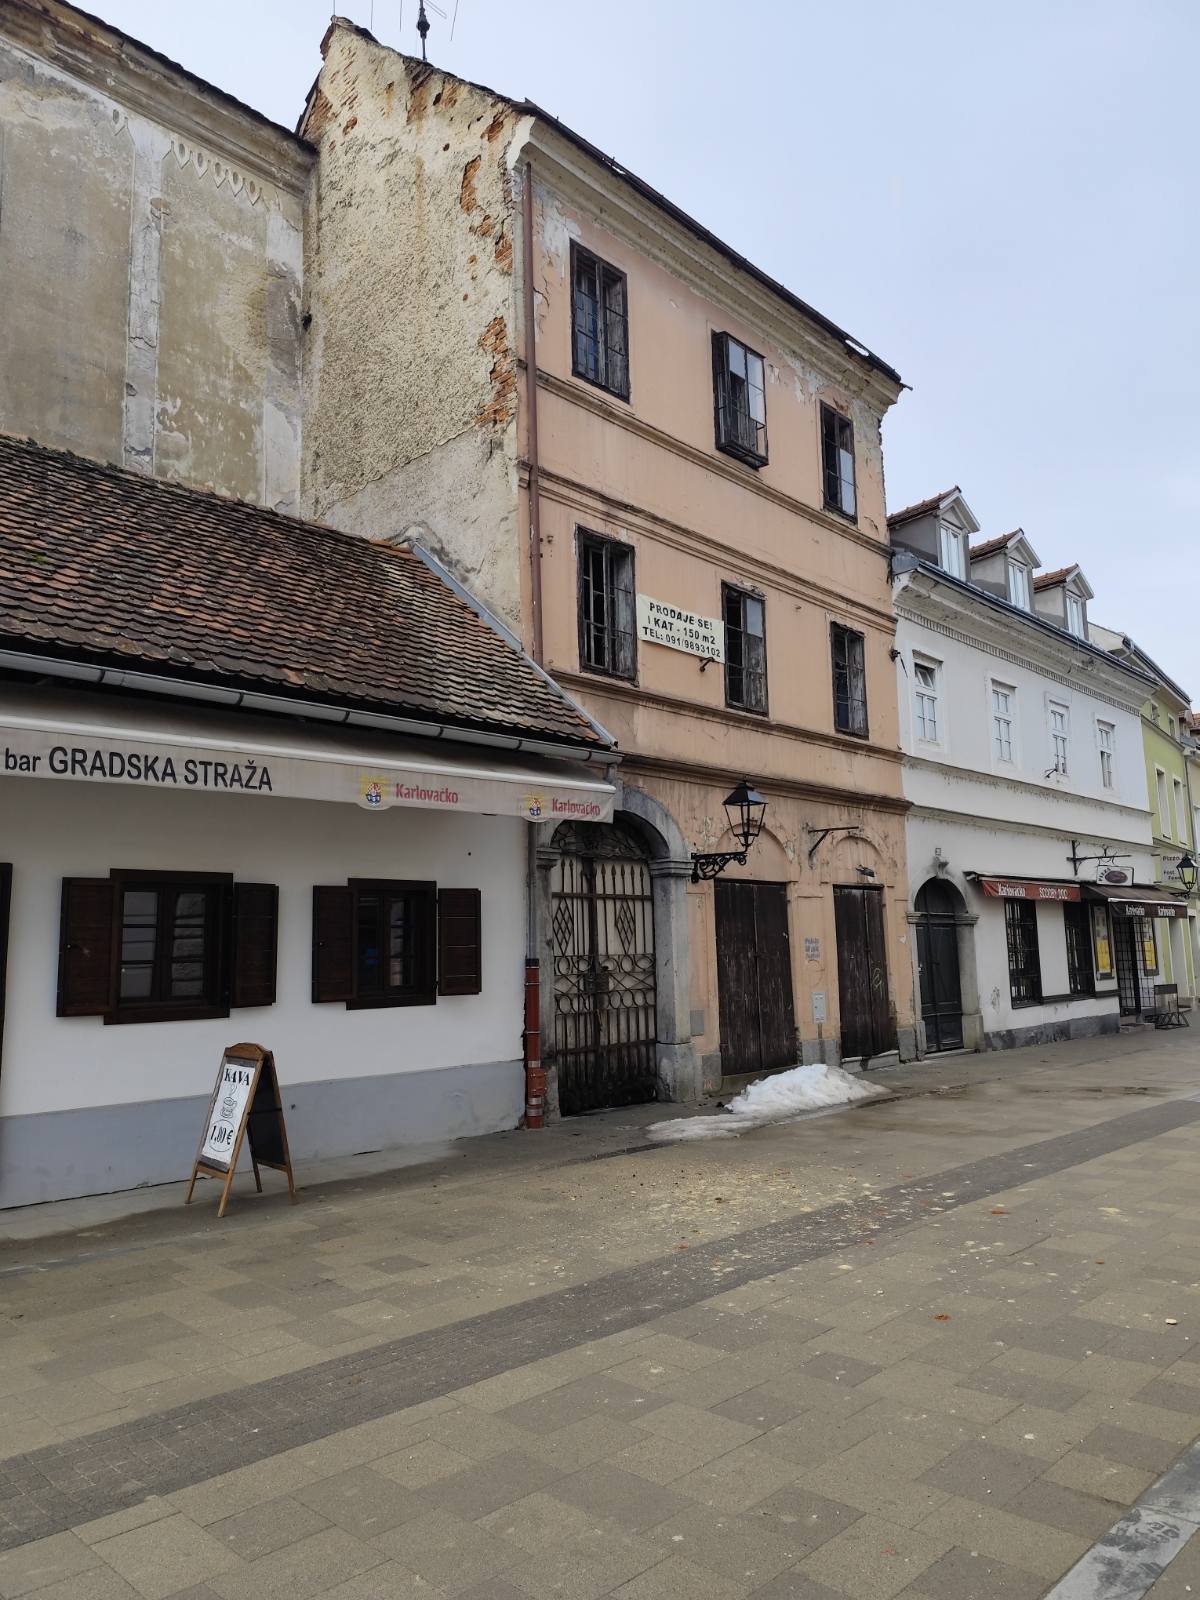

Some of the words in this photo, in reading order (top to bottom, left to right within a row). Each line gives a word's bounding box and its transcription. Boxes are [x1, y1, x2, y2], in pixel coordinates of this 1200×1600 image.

[649, 602, 695, 625] PRODAJE
[698, 619, 713, 631] SE!
[642, 626, 664, 640] TEL:
[654, 617, 674, 632] KAT
[683, 627, 700, 640] 150
[702, 634, 716, 645] m2
[4, 747, 41, 773] bar
[48, 746, 177, 783] GRADSKA
[184, 759, 273, 792] STRAŽA
[396, 783, 458, 803] Karlovačko
[552, 798, 601, 816] Karlovačko
[224, 1068, 250, 1085] KAVA
